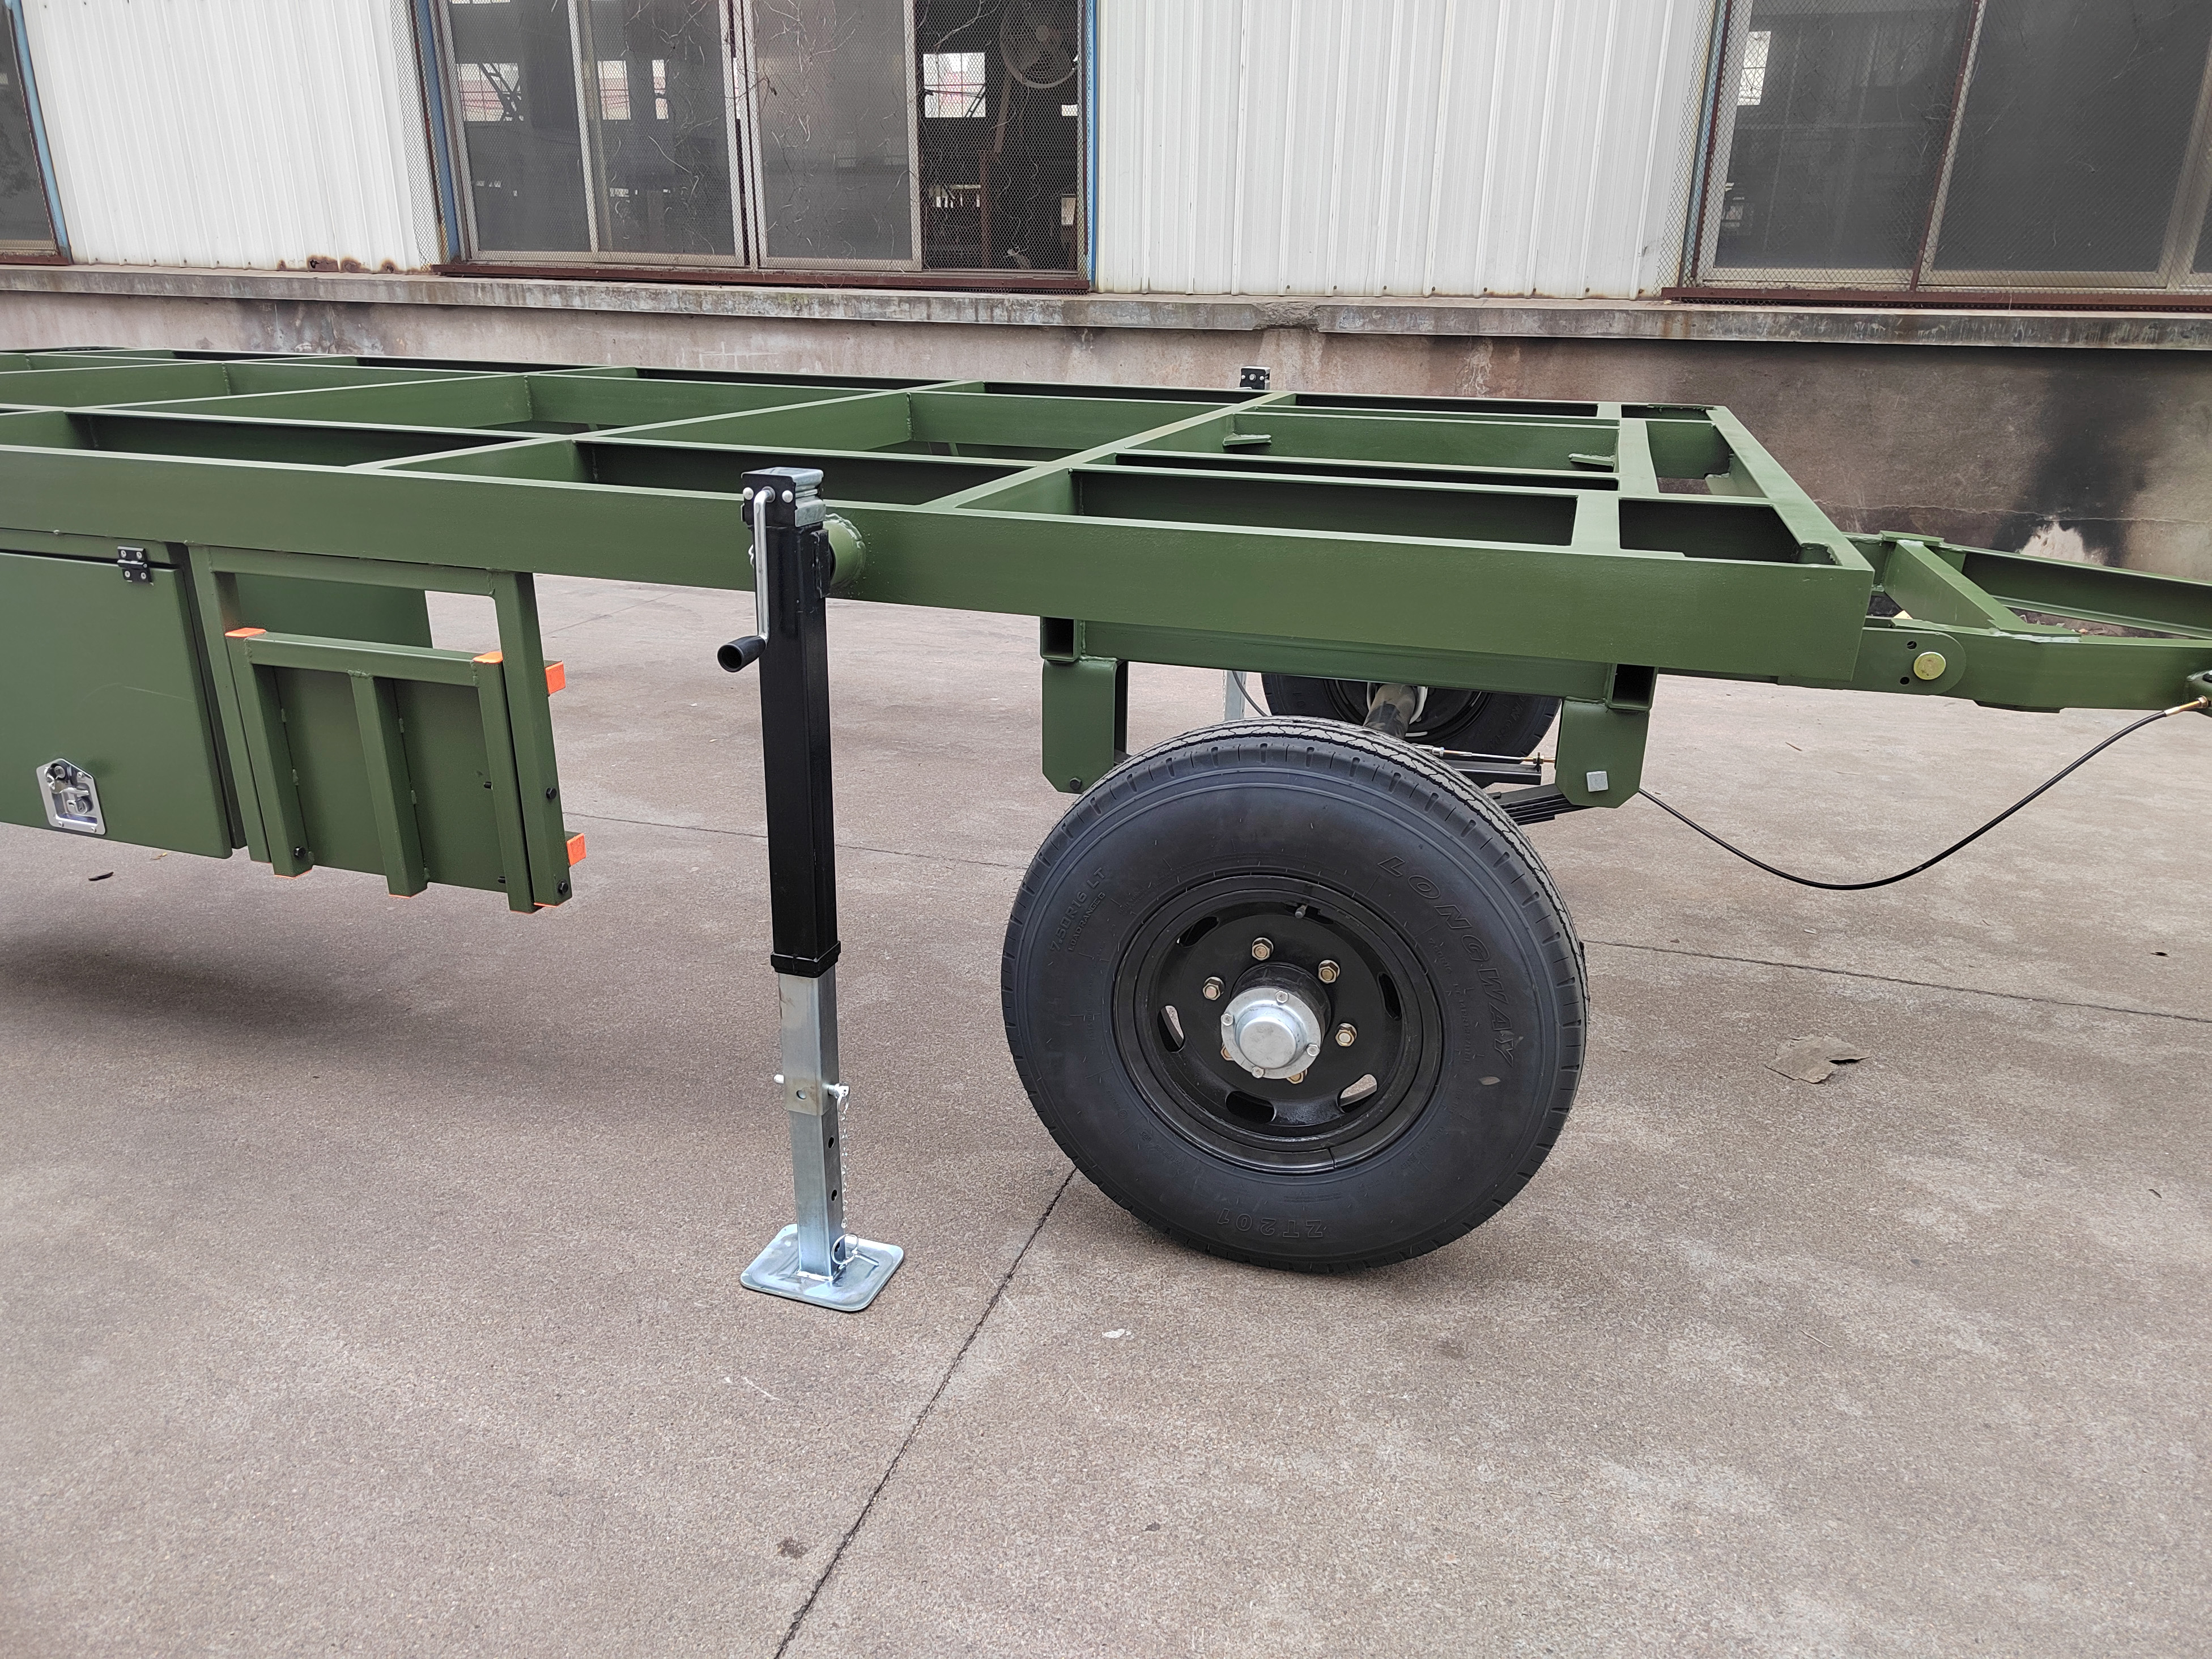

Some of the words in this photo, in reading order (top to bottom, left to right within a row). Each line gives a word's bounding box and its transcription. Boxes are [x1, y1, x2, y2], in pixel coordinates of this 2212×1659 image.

[1050, 891, 1087, 951] 7.50R16
[1087, 867, 1105, 888] LT
[1377, 856, 1515, 1067] LONGWAY
[1217, 1207, 1323, 1238] ZT201
